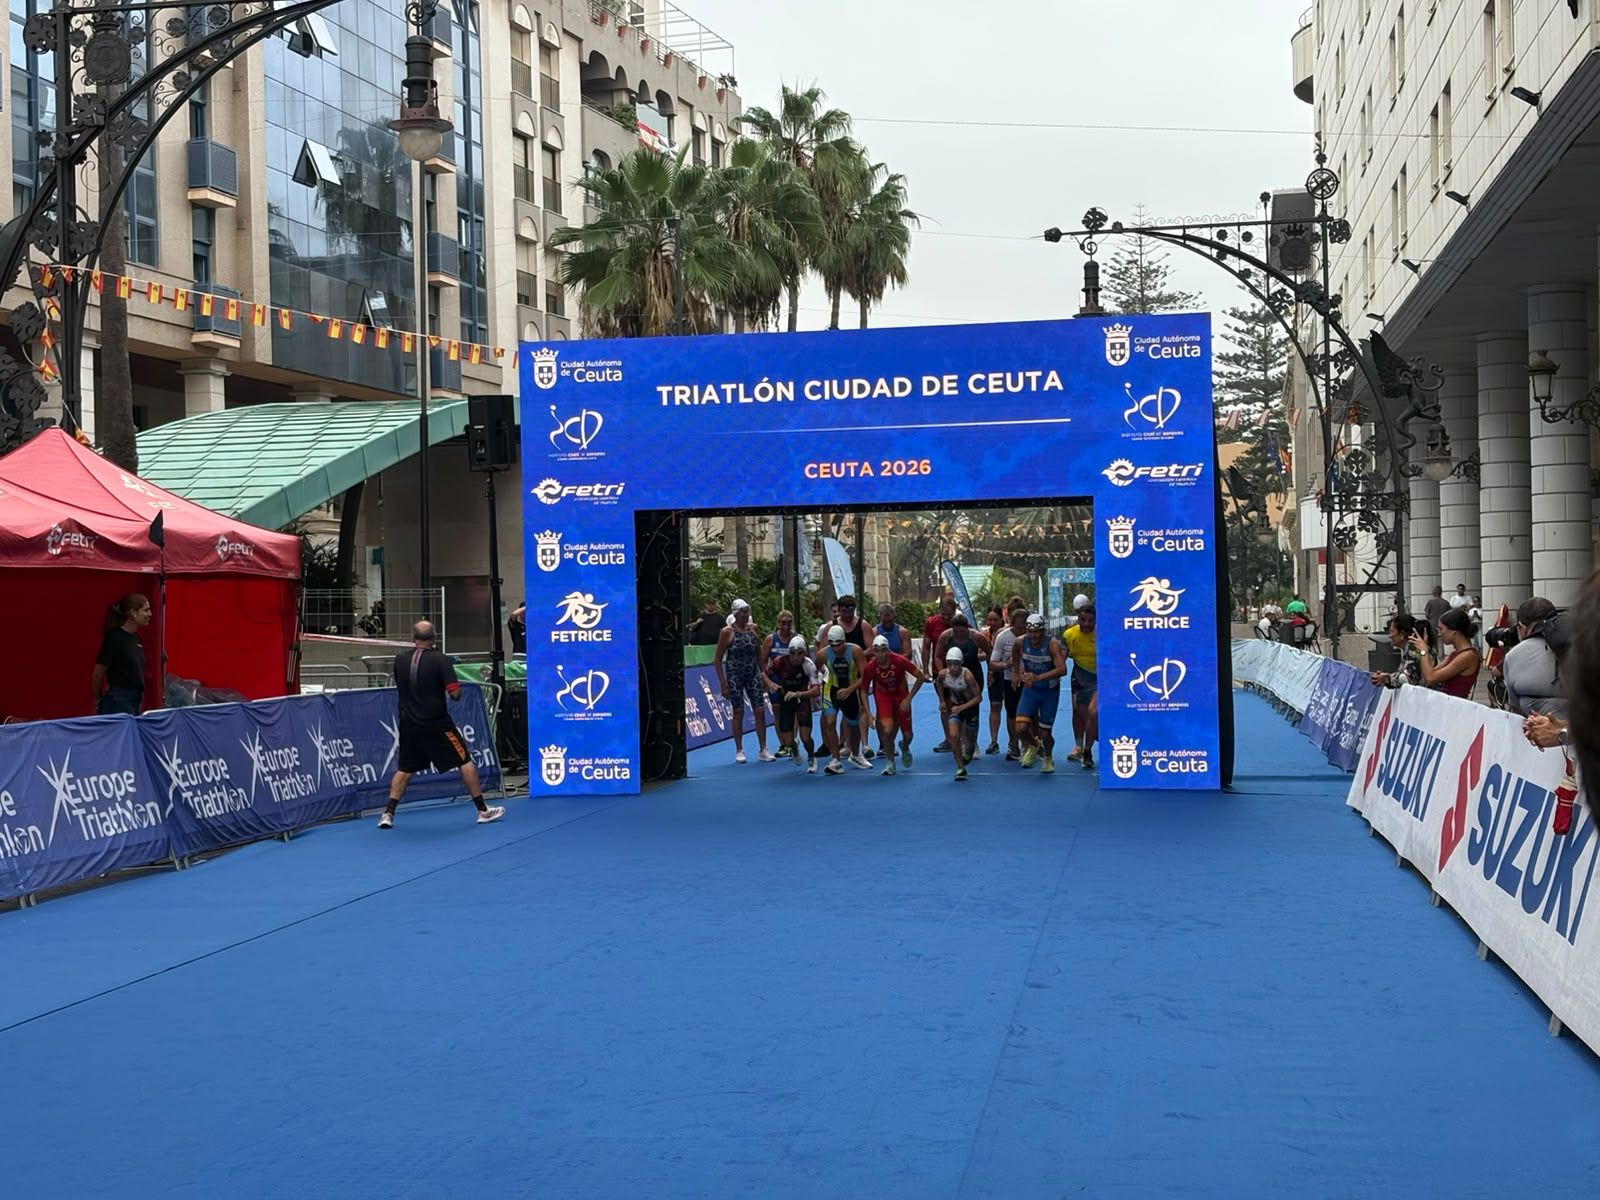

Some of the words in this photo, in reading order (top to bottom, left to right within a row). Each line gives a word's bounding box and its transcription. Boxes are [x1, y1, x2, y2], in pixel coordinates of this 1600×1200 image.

[1134, 336, 1160, 344] Ciudad
[1162, 335, 1200, 343] Autónoma
[1148, 343, 1201, 359] Ceuta
[574, 368, 622, 382] Ceuta
[657, 376, 795, 406] TRIATLÓN
[804, 376, 912, 401] CIUDAD
[922, 374, 958, 396] DE
[968, 370, 1063, 394] CEUTA
[805, 461, 874, 479] CEUTA
[881, 459, 931, 476] 2026
[1138, 529, 1163, 537] Ciudad
[1165, 528, 1204, 536] Autónoma
[564, 543, 588, 551] Ciudad
[589, 542, 625, 550] Autónoma
[1138, 537, 1148, 545] de
[1152, 537, 1204, 551] Ceuta
[577, 551, 625, 565] Ceuta
[1124, 616, 1190, 630] FETRICE
[551, 630, 612, 642] FETRICE
[258, 745, 301, 774] Europe
[594, 757, 629, 765] Autónoma
[1141, 750, 1167, 758] Ciudad
[1169, 749, 1207, 757] Autónoma
[176, 757, 230, 788] Europe
[582, 765, 630, 779] Ceuta
[1142, 758, 1152, 766] de
[1156, 758, 1208, 773] Ceuta
[1376, 718, 1446, 823] SUZUKI
[66, 769, 137, 804] Europe
[264, 773, 317, 802] Triathlon
[182, 787, 251, 819] Triathlon
[72, 800, 162, 841] Triathlon
[1467, 763, 1600, 946] SUZUKI
